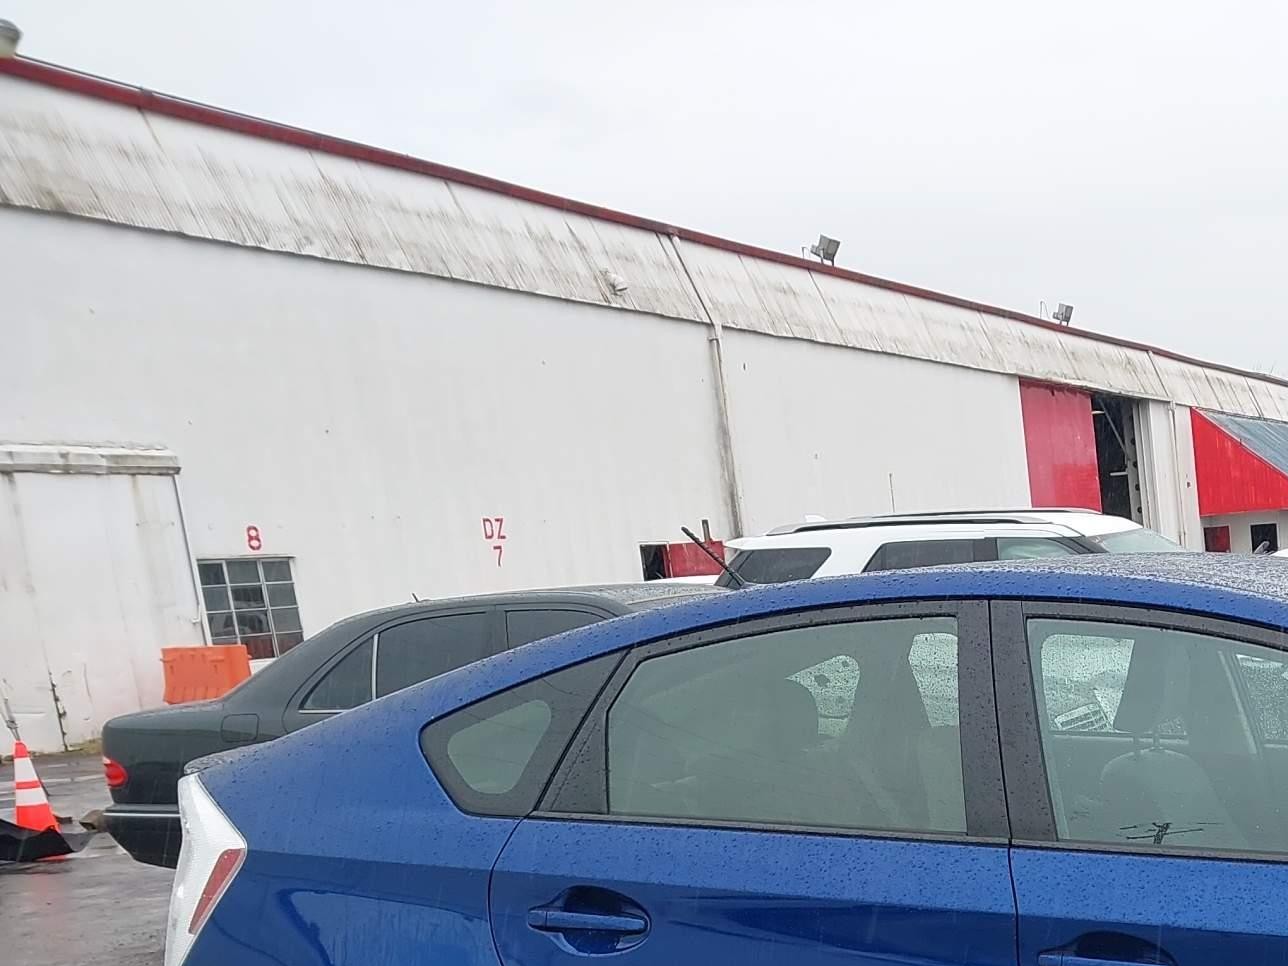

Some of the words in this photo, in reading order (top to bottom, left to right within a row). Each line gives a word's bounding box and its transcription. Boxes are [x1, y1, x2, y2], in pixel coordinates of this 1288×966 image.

[246, 525, 262, 551] 8
[482, 517, 506, 540] DZ
[492, 545, 503, 567] 7
